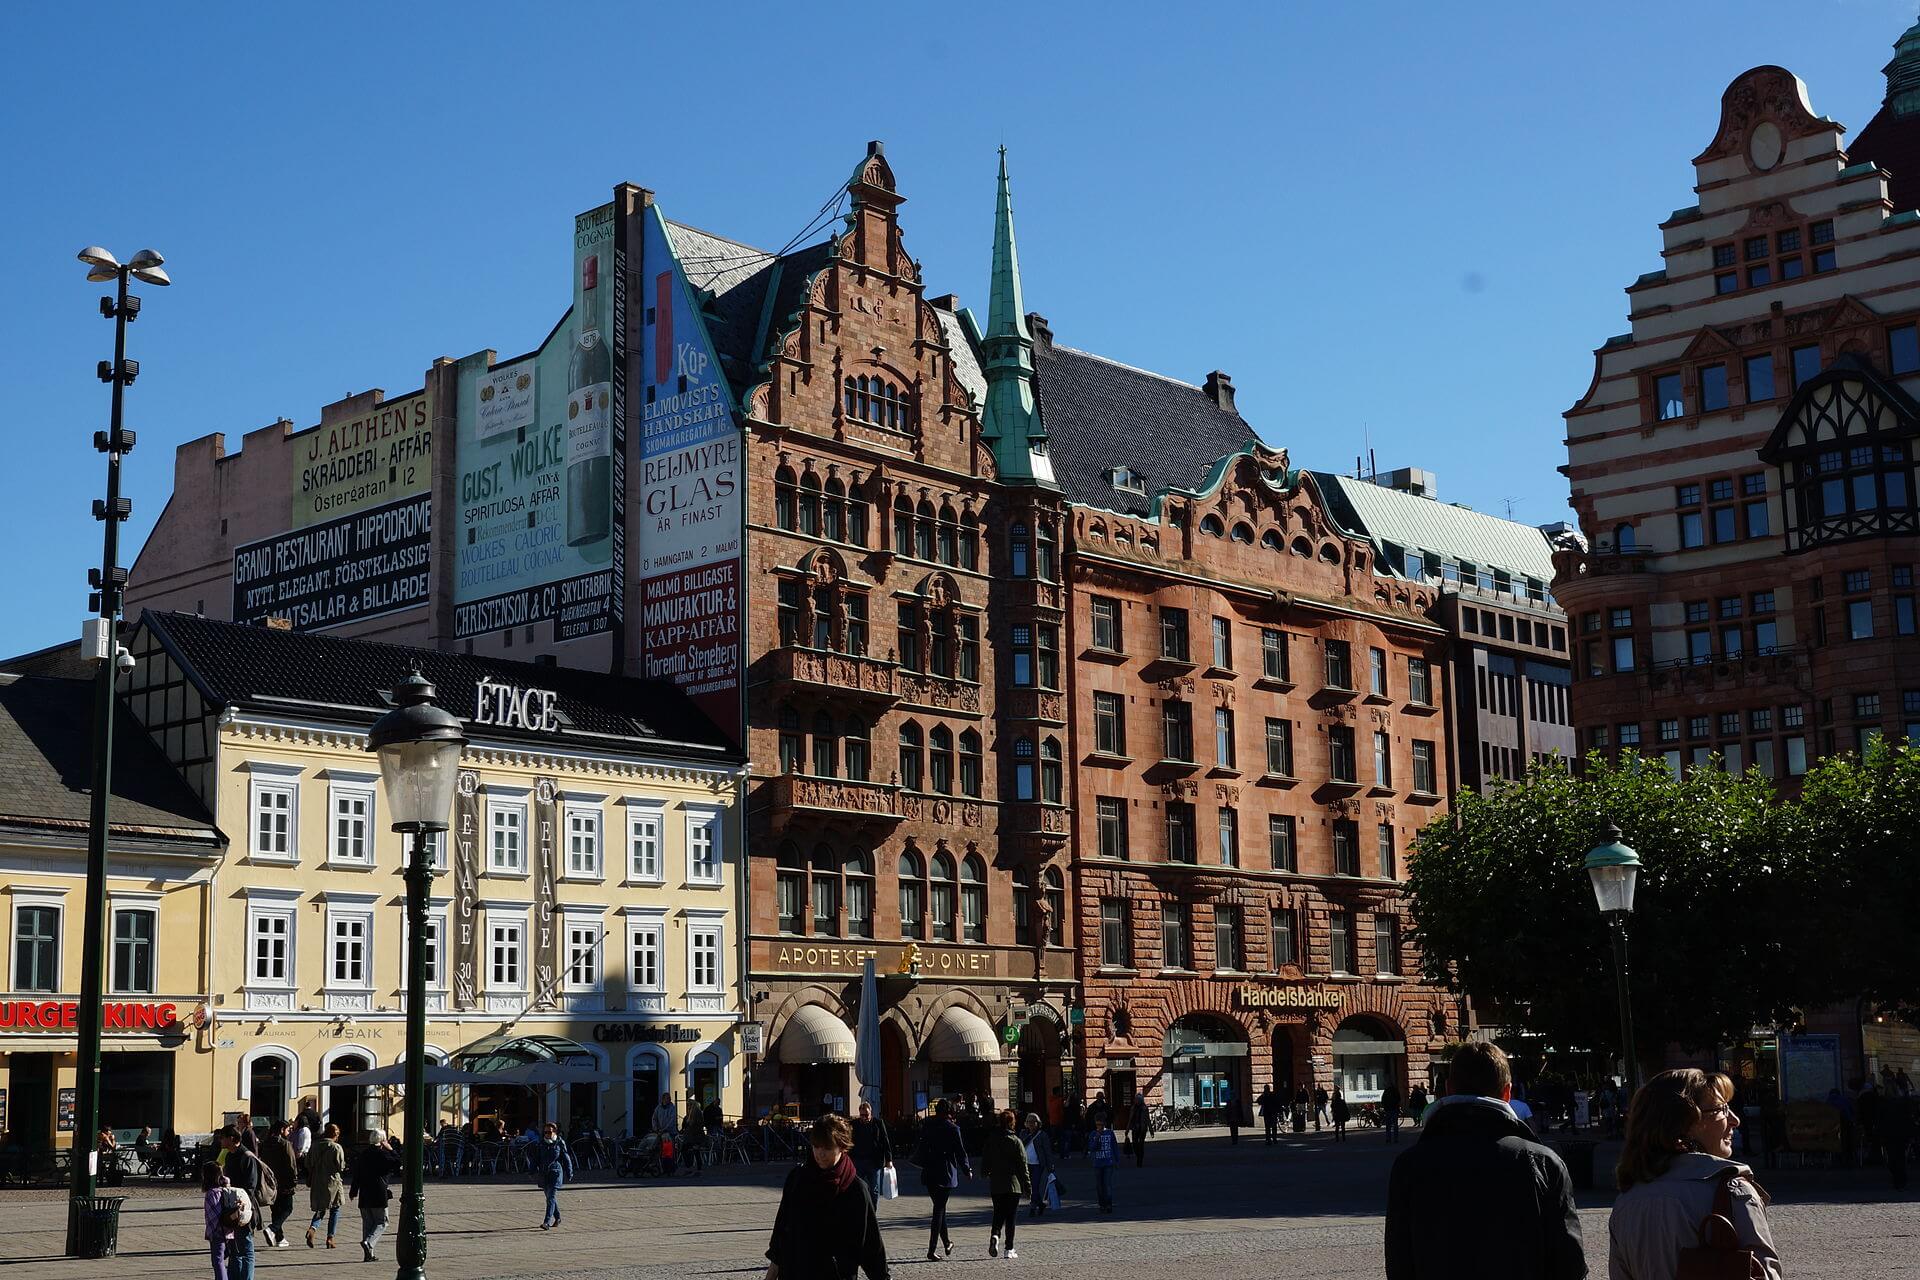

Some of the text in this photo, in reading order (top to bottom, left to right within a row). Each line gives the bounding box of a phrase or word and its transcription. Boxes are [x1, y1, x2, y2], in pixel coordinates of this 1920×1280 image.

[646, 423, 713, 454] SKOMAKAREGATAN
[302, 447, 377, 492] SKRÄDDERI
[389, 431, 432, 466] AFFÄR
[462, 423, 563, 505] GUST. WOLKE
[644, 439, 738, 485] REIJMYRE
[314, 467, 415, 512] Östergatan 12
[614, 447, 625, 515] GENOM
[646, 470, 735, 515] GLAS
[464, 496, 525, 524] SPIRITUOSA
[657, 505, 722, 533] ÄR FINAST
[235, 500, 431, 585] GRAND RESTAURANT HIPPODROME
[462, 523, 562, 565] WOLKES CALORIC
[653, 549, 694, 568] HAMNGATAN
[701, 546, 707, 557] 2
[715, 540, 738, 554] MALMÖ
[461, 545, 565, 588] BOUTELLEAU COGNAC
[614, 521, 625, 624] ANNONSERA
[647, 565, 733, 600] MALMÖ BILLIGASTE
[349, 596, 358, 613] &
[561, 572, 613, 605] SKYLTFABRIK
[603, 595, 610, 612] 4
[455, 591, 529, 637] CHRISTENSON
[531, 592, 540, 619] &
[562, 620, 590, 637] TELEFON
[645, 641, 737, 678] Florentin Steneberg
[460, 962, 472, 979] 30
[540, 965, 551, 982] 30
[778, 948, 877, 966] APOTEKET
[1240, 985, 1346, 1009] Handelsbanken
[0, 1001, 77, 1028] URGE
[103, 1002, 177, 1028] KING
[1115, 1059, 1123, 1067] 10
